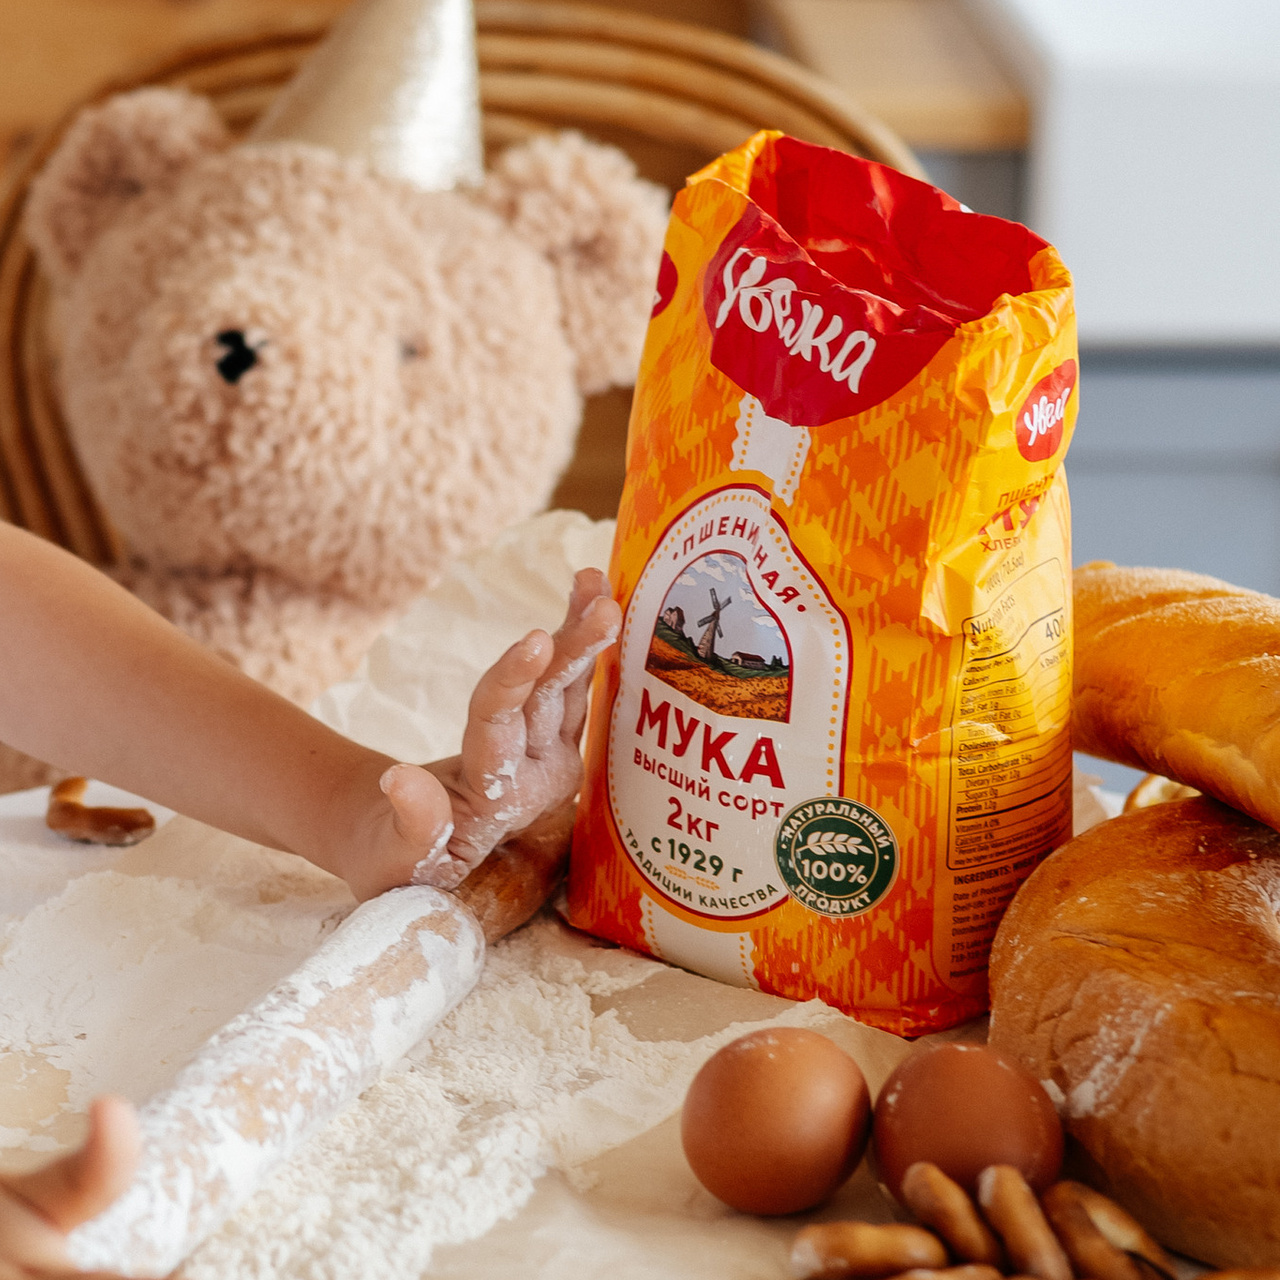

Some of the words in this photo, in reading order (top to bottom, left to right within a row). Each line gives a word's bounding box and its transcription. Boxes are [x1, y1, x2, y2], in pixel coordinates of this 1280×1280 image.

[683, 516, 801, 604] ПШЕНИНАЯ
[635, 687, 786, 790] МУКА
[782, 803, 894, 849] НАТУРАЛЬНЫЙ
[626, 828, 693, 903] ТРАДИЦИИ
[698, 883, 779, 911] КАЧЕСТВА
[668, 837, 724, 877] 1929
[800, 858, 868, 885] 100%
[794, 884, 872, 914] ПРОДУКТ
